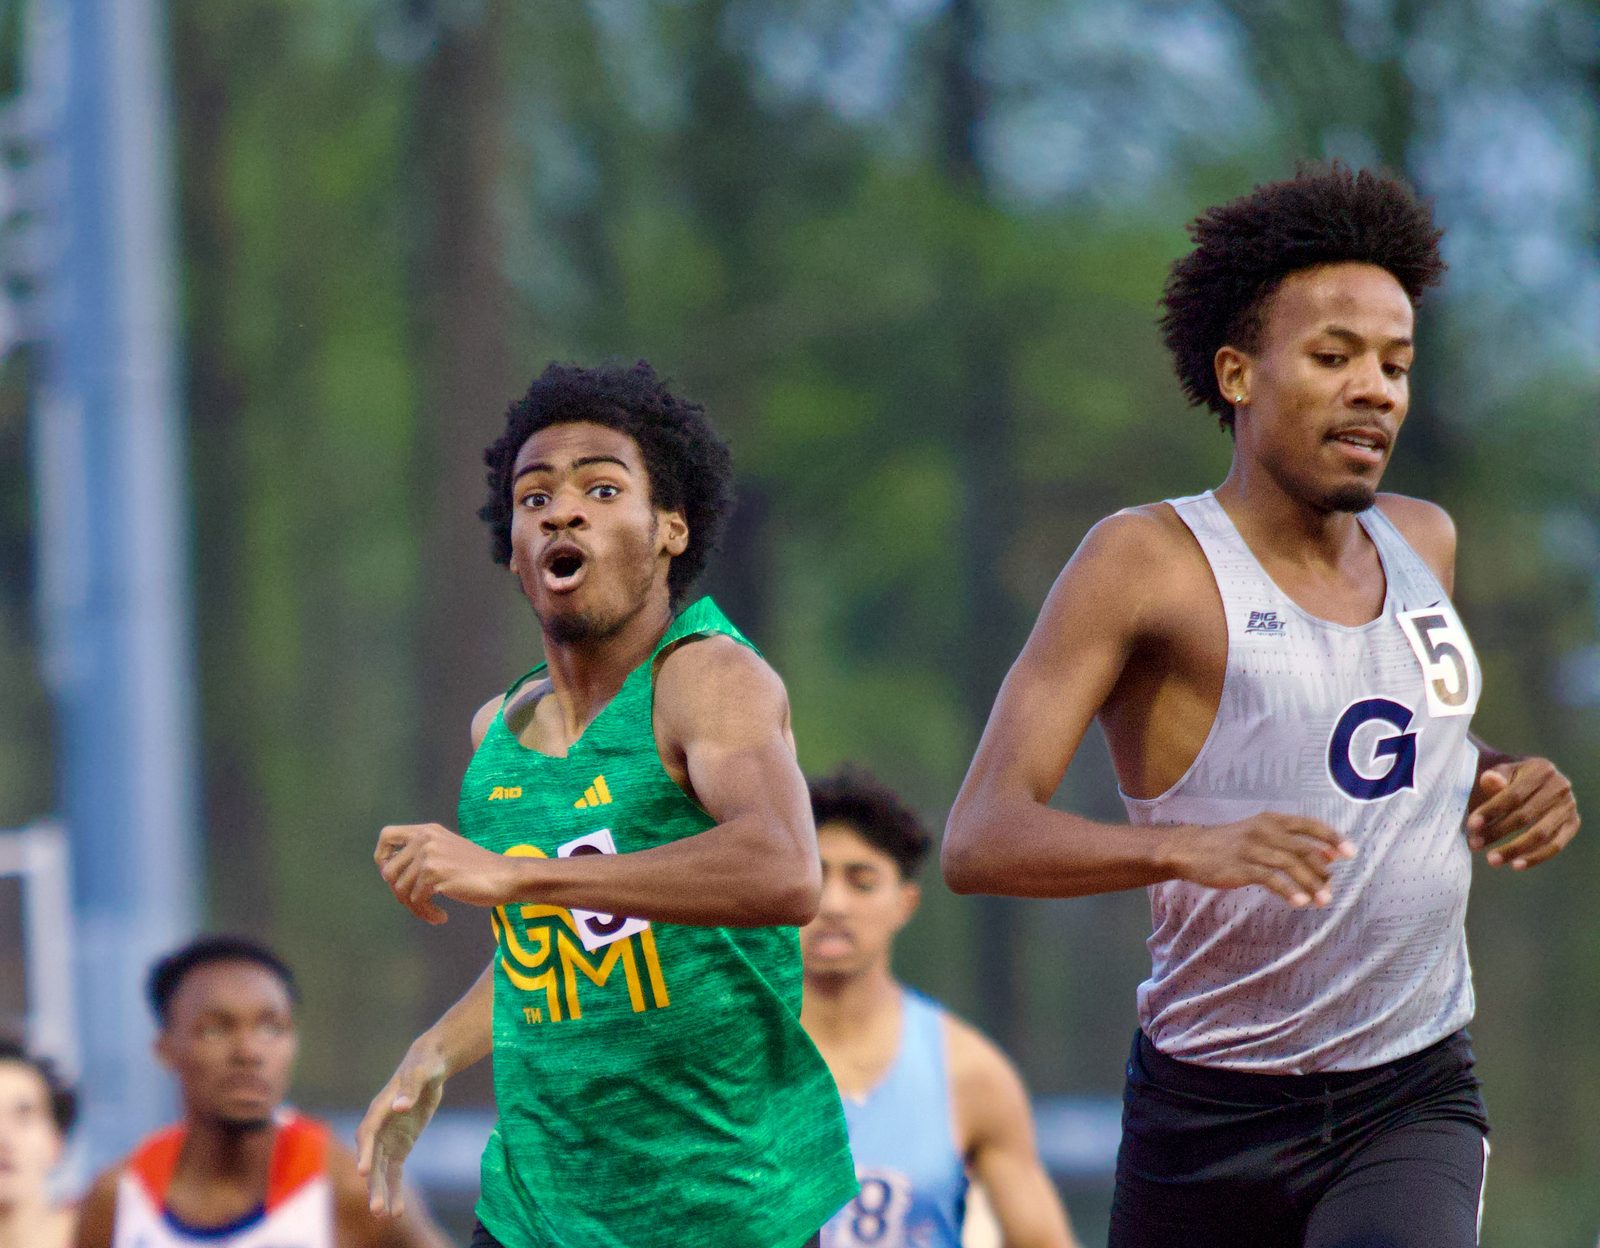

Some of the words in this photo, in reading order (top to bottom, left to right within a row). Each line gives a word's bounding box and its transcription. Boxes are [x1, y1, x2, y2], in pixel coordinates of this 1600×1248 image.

[1247, 620, 1286, 630] EAST
[1250, 611, 1277, 621] BIG
[1411, 614, 1469, 707] 5
[1327, 697, 1418, 802] G
[488, 786, 522, 801] A10
[523, 1007, 542, 1025] TM
[851, 1178, 892, 1244] 8
